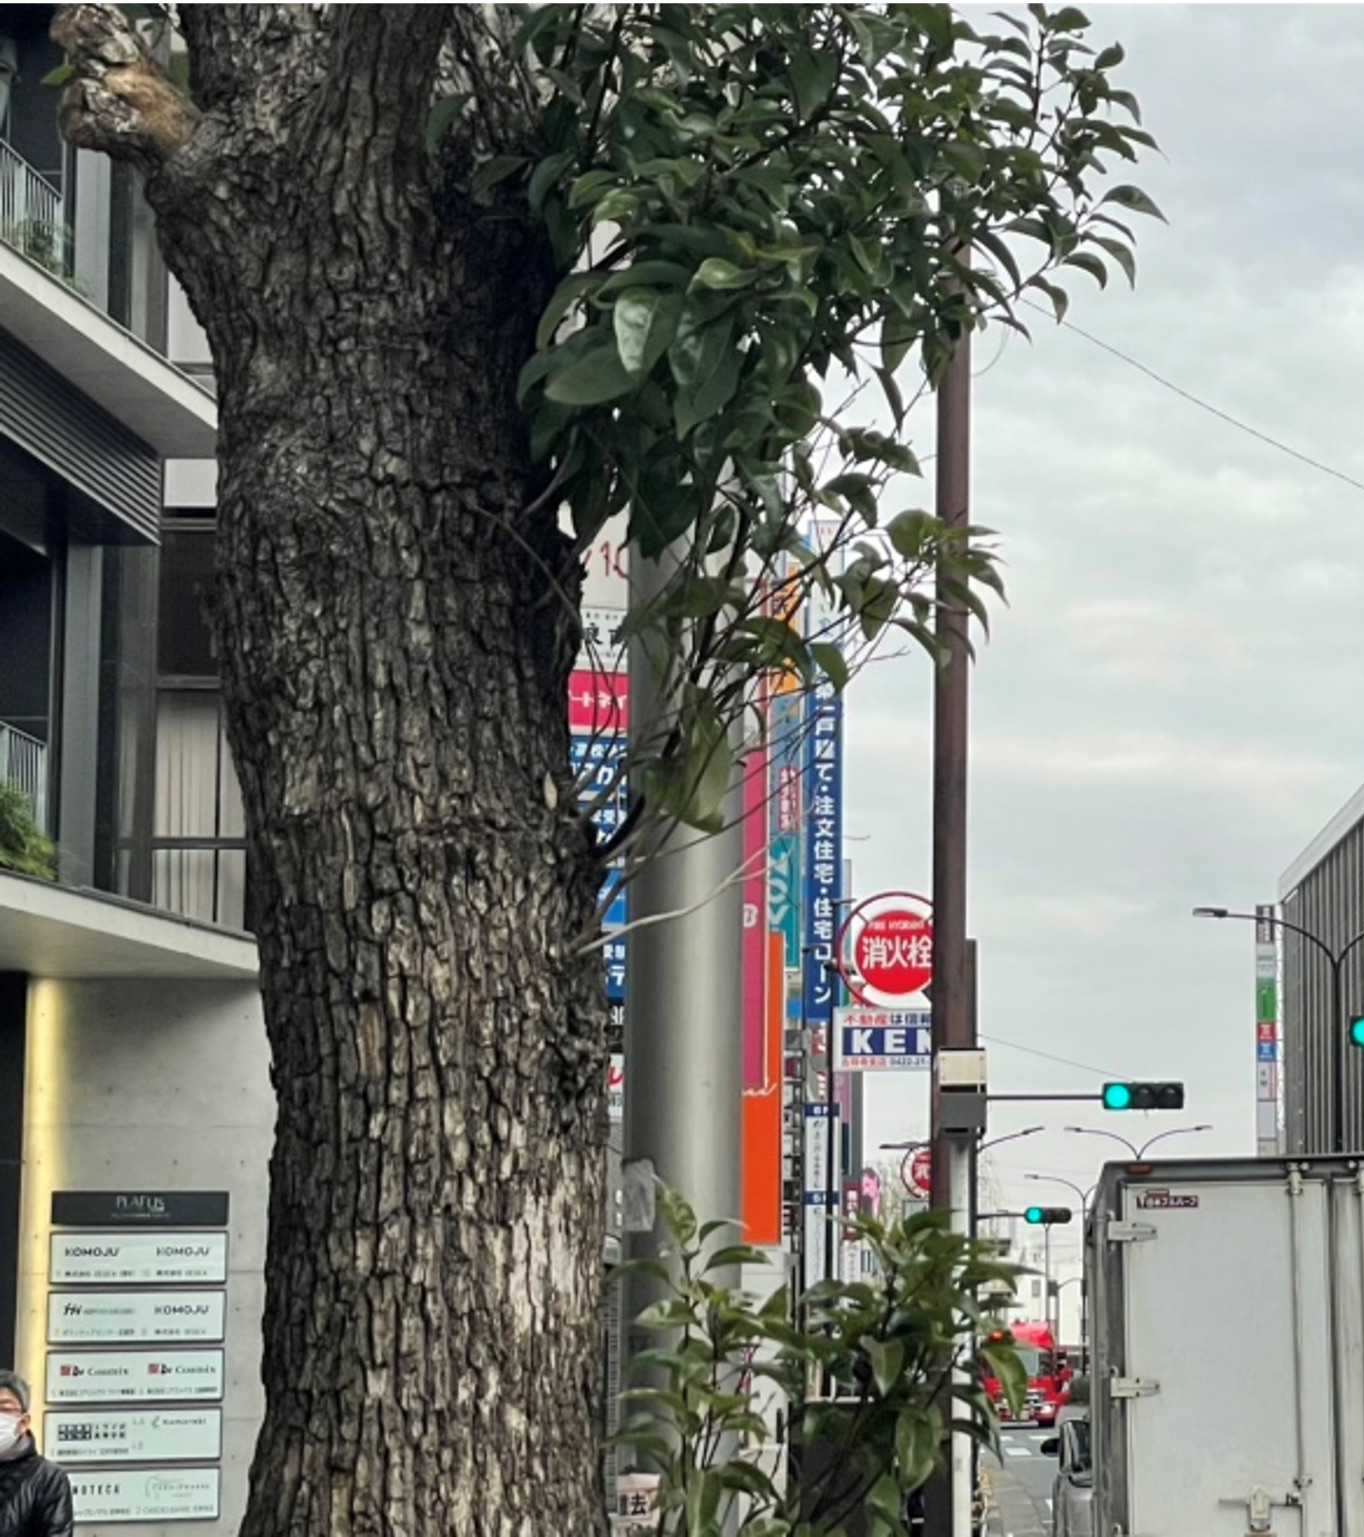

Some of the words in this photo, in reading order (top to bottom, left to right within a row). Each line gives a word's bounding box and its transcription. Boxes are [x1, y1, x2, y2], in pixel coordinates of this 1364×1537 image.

[862, 935, 932, 970] 消火栓
[65, 1246, 120, 1258] KOMOJU
[156, 1245, 210, 1257] KOMOJU
[154, 1304, 209, 1316] KOMOJU
[73, 1484, 119, 1496] NOTECA
